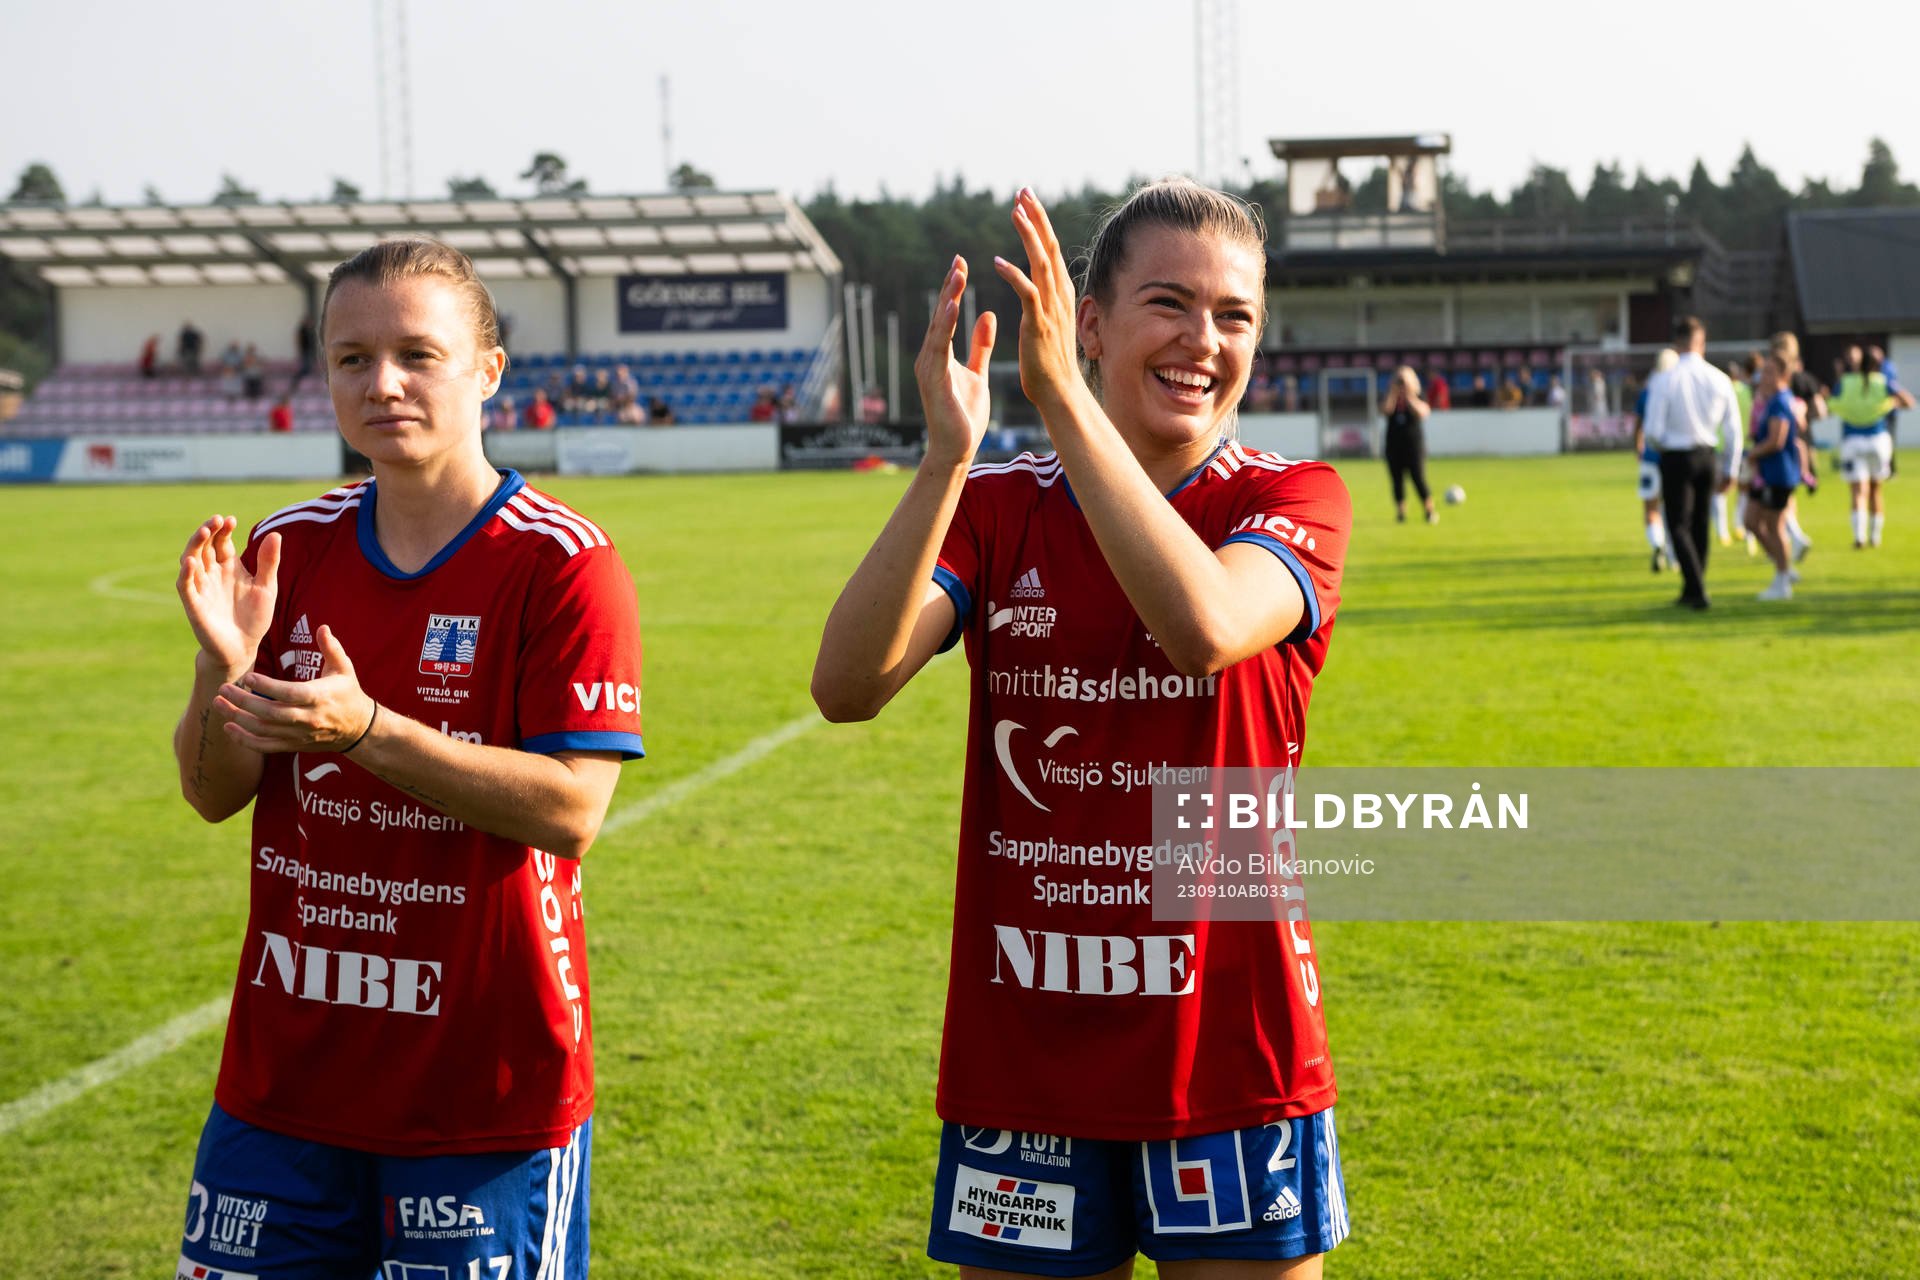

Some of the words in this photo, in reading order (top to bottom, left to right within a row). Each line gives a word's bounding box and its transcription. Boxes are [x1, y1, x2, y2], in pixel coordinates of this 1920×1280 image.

[1010, 588, 1045, 598] adidas
[1014, 606, 1057, 622] INTER
[1010, 621, 1055, 638] SPORT
[416, 686, 450, 697] VITTSJÖ
[453, 690, 470, 699] GIK
[1037, 758, 1103, 792] Vittsjö
[1111, 760, 1208, 793] Sjukhem
[300, 789, 361, 826] Vittsjö
[1033, 875, 1151, 907] Sparbank
[250, 930, 442, 1016] NIBE
[990, 924, 1196, 996] NIBE
[1020, 1149, 1071, 1168] VENTILATION
[216, 1193, 268, 1222] VITTSJÖ
[399, 1195, 485, 1228] FASA
[968, 1185, 1057, 1214] HYNGARPS
[1262, 1206, 1302, 1222] adida
[210, 1212, 263, 1248] LUFT
[957, 1199, 1066, 1232] FRÄSTEKNIK
[209, 1239, 256, 1258] VENTILATION
